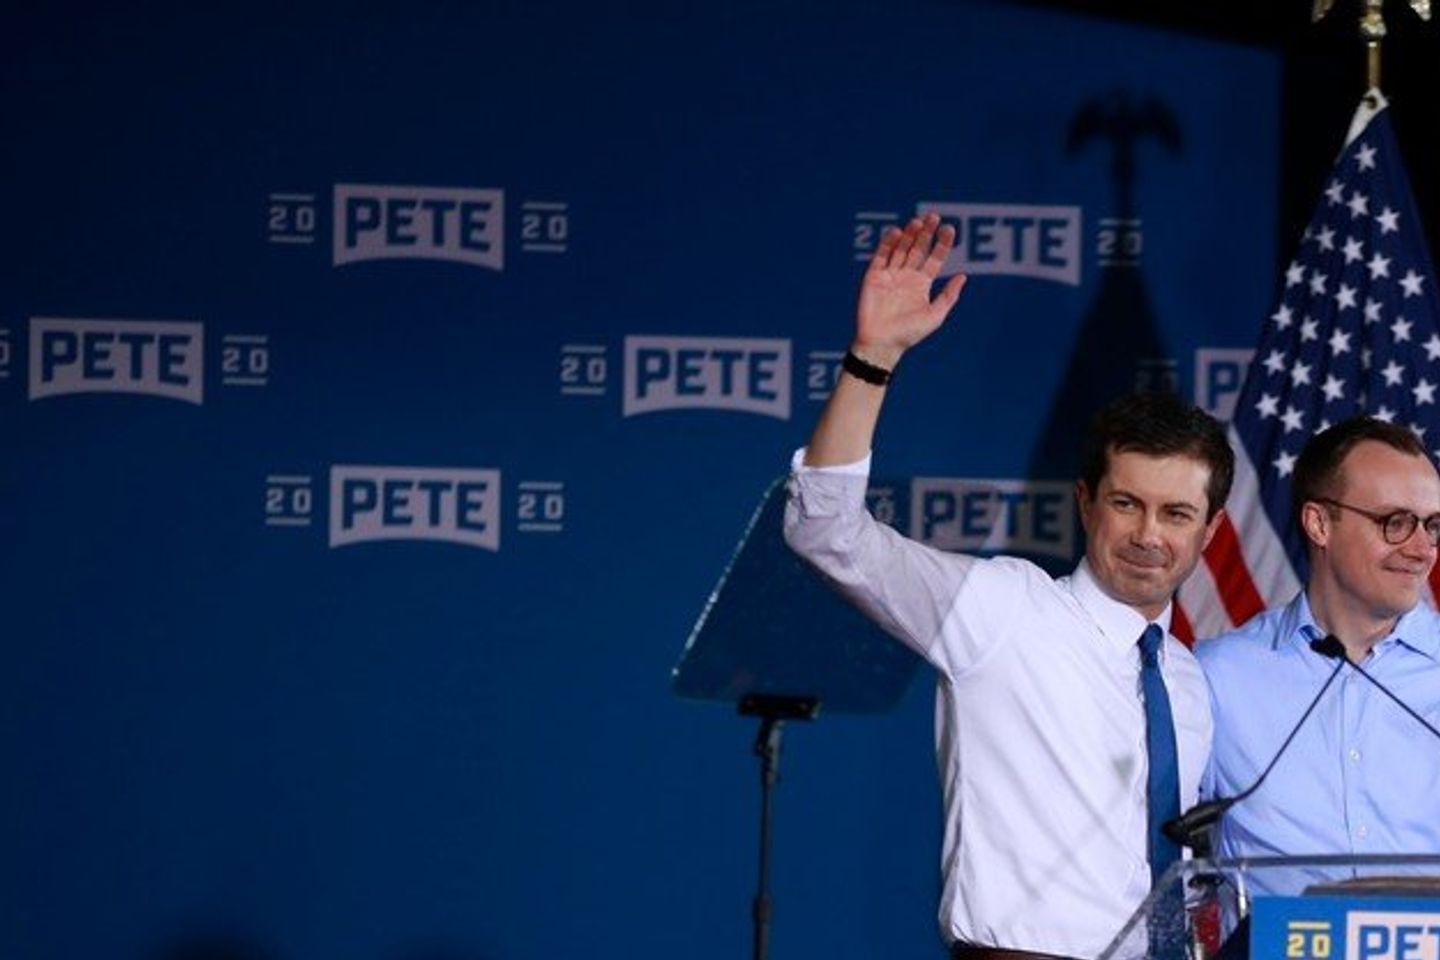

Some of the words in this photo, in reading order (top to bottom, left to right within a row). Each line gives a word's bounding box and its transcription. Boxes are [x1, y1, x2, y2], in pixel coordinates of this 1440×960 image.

[269, 206, 315, 232] 20
[344, 198, 493, 253] PETE
[522, 214, 568, 240] 20
[1098, 229, 1144, 256] 20
[40, 330, 193, 387] PETE
[222, 349, 268, 373] 20
[560, 356, 607, 382] 20
[635, 346, 780, 402] PETE
[265, 488, 311, 512] 20
[340, 478, 488, 532] PETE
[518, 494, 563, 519] 20
[922, 489, 1066, 544] PETE
[1287, 934, 1331, 958] 20
